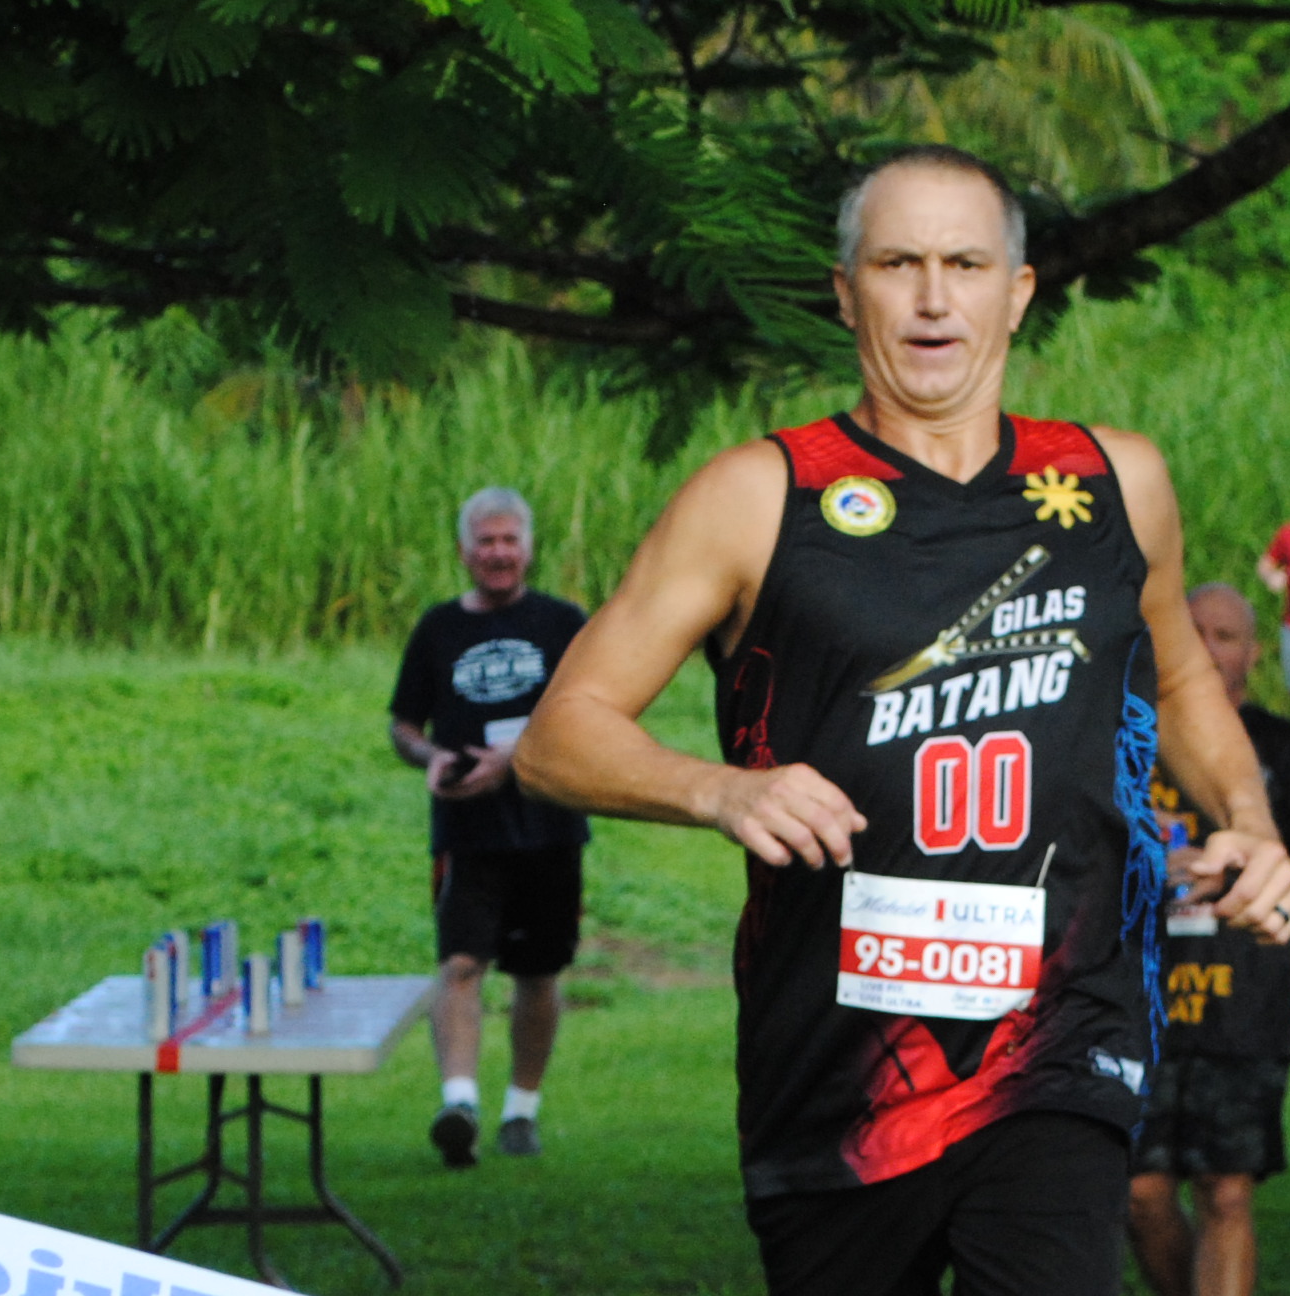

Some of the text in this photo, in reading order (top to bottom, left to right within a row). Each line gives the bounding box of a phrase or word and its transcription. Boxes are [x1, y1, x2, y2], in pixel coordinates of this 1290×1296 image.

[991, 585, 1086, 638] GILAS
[866, 650, 1075, 746] BATANG
[914, 730, 1032, 856] 00
[952, 902, 1036, 925] ULTRA
[854, 934, 1023, 987] 95-0081
